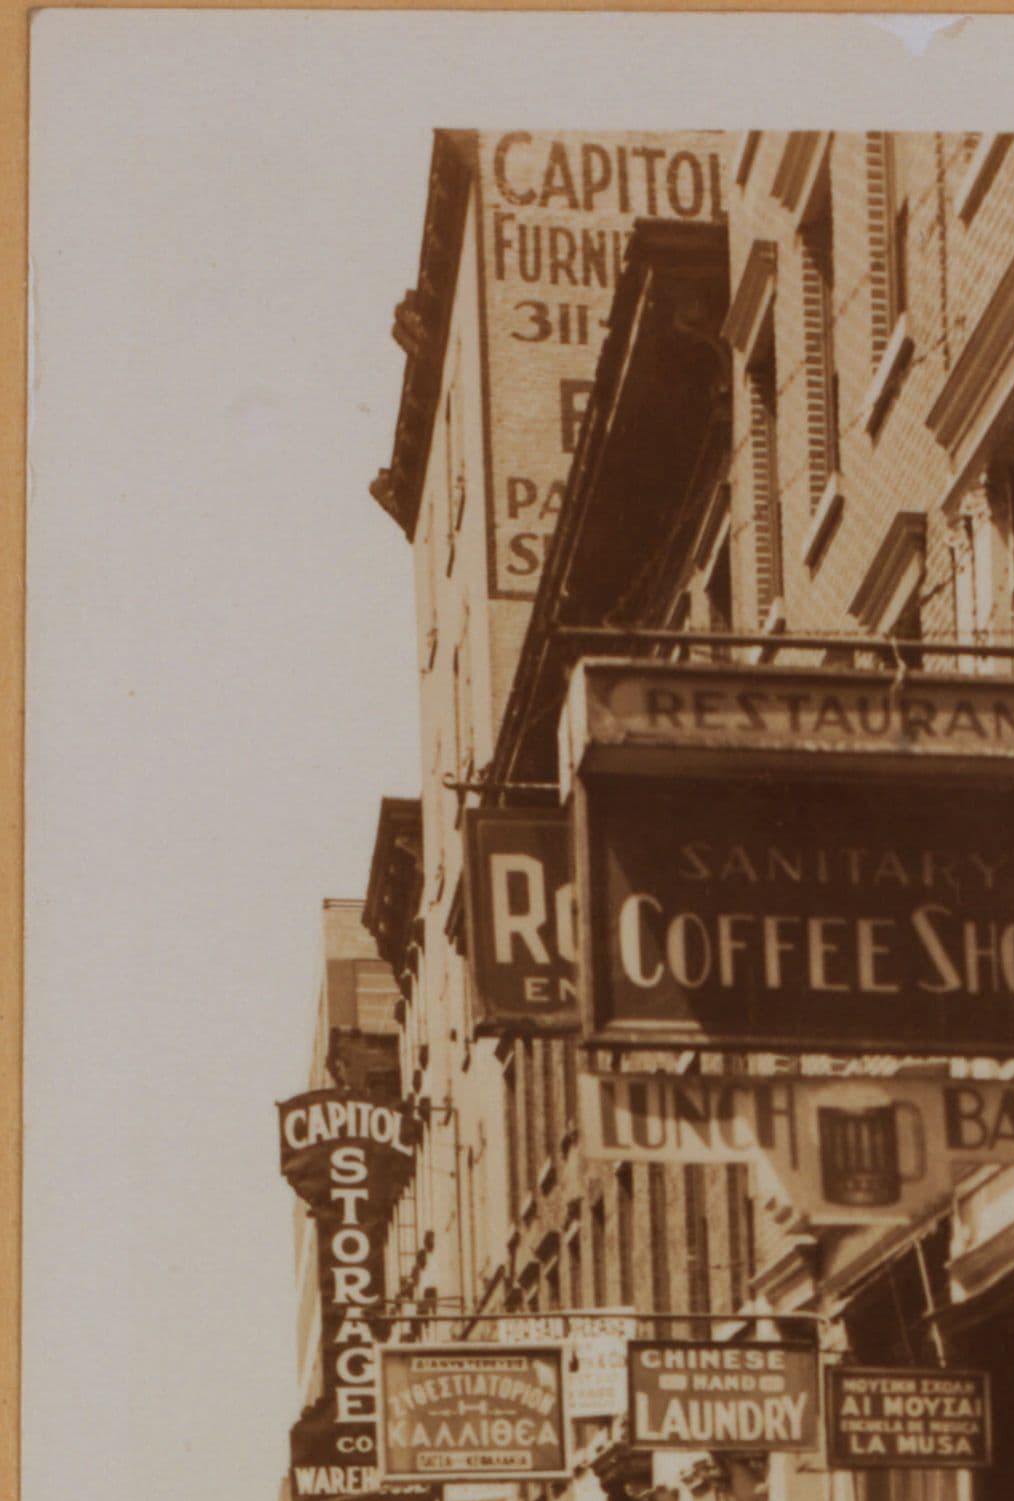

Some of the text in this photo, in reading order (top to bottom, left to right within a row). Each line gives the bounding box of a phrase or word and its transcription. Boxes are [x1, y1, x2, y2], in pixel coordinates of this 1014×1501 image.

[494, 131, 724, 218] CAPITOL
[493, 211, 634, 289] FURNI
[680, 841, 1006, 890] SANITARY
[619, 893, 901, 994] COFFEE
[284, 1101, 414, 1157] CAPITOL
[600, 1082, 799, 1171] LUNCH
[330, 1146, 381, 1424] STORAGE
[640, 1350, 785, 1370] CHINESE
[692, 1373, 757, 1392] HAND
[635, 1391, 808, 1442] LAUNDRY
[849, 1433, 975, 1457] LA MUSA
